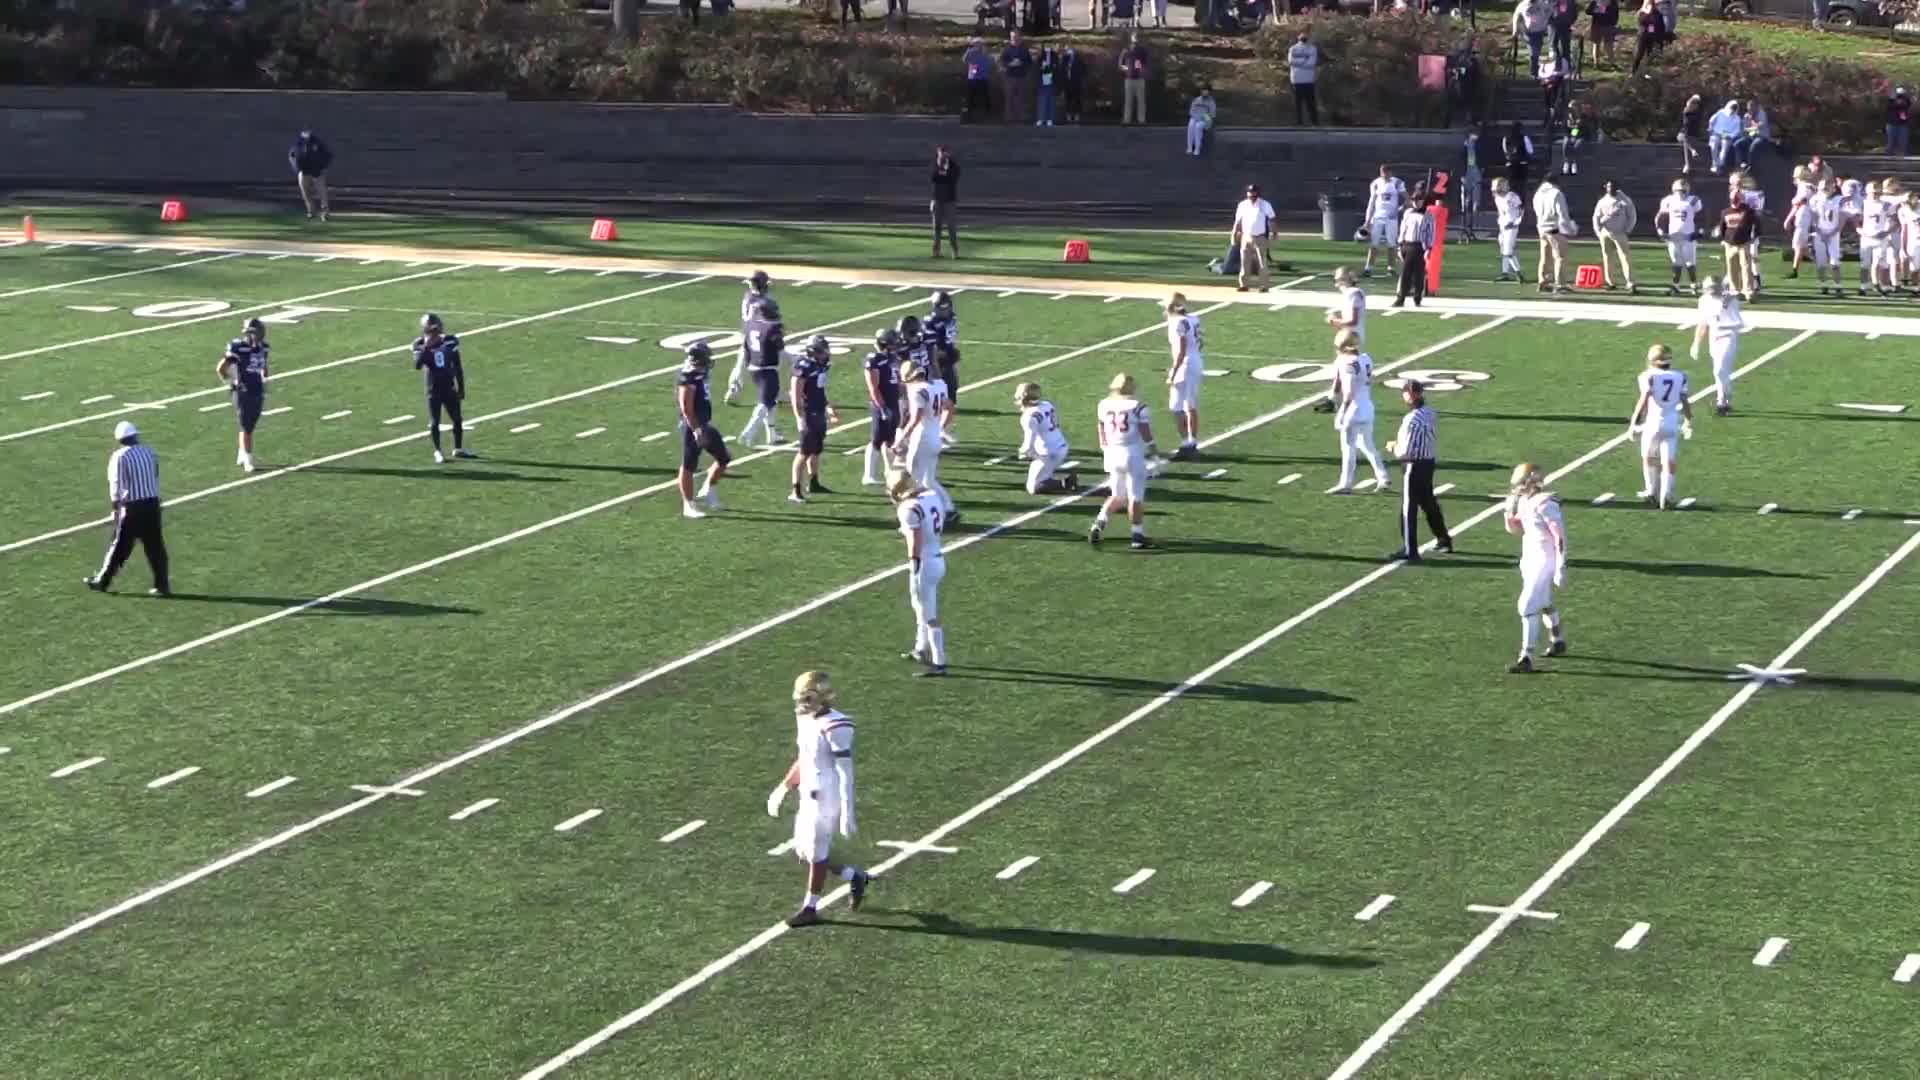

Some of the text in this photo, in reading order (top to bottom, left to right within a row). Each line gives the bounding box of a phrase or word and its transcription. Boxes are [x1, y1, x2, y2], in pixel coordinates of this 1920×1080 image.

[1433, 172, 1448, 193] 2
[593, 221, 609, 240] 10
[1579, 268, 1597, 285] 30
[1662, 379, 1680, 401] 7
[1107, 411, 1129, 432] 33
[930, 507, 943, 534] 2
